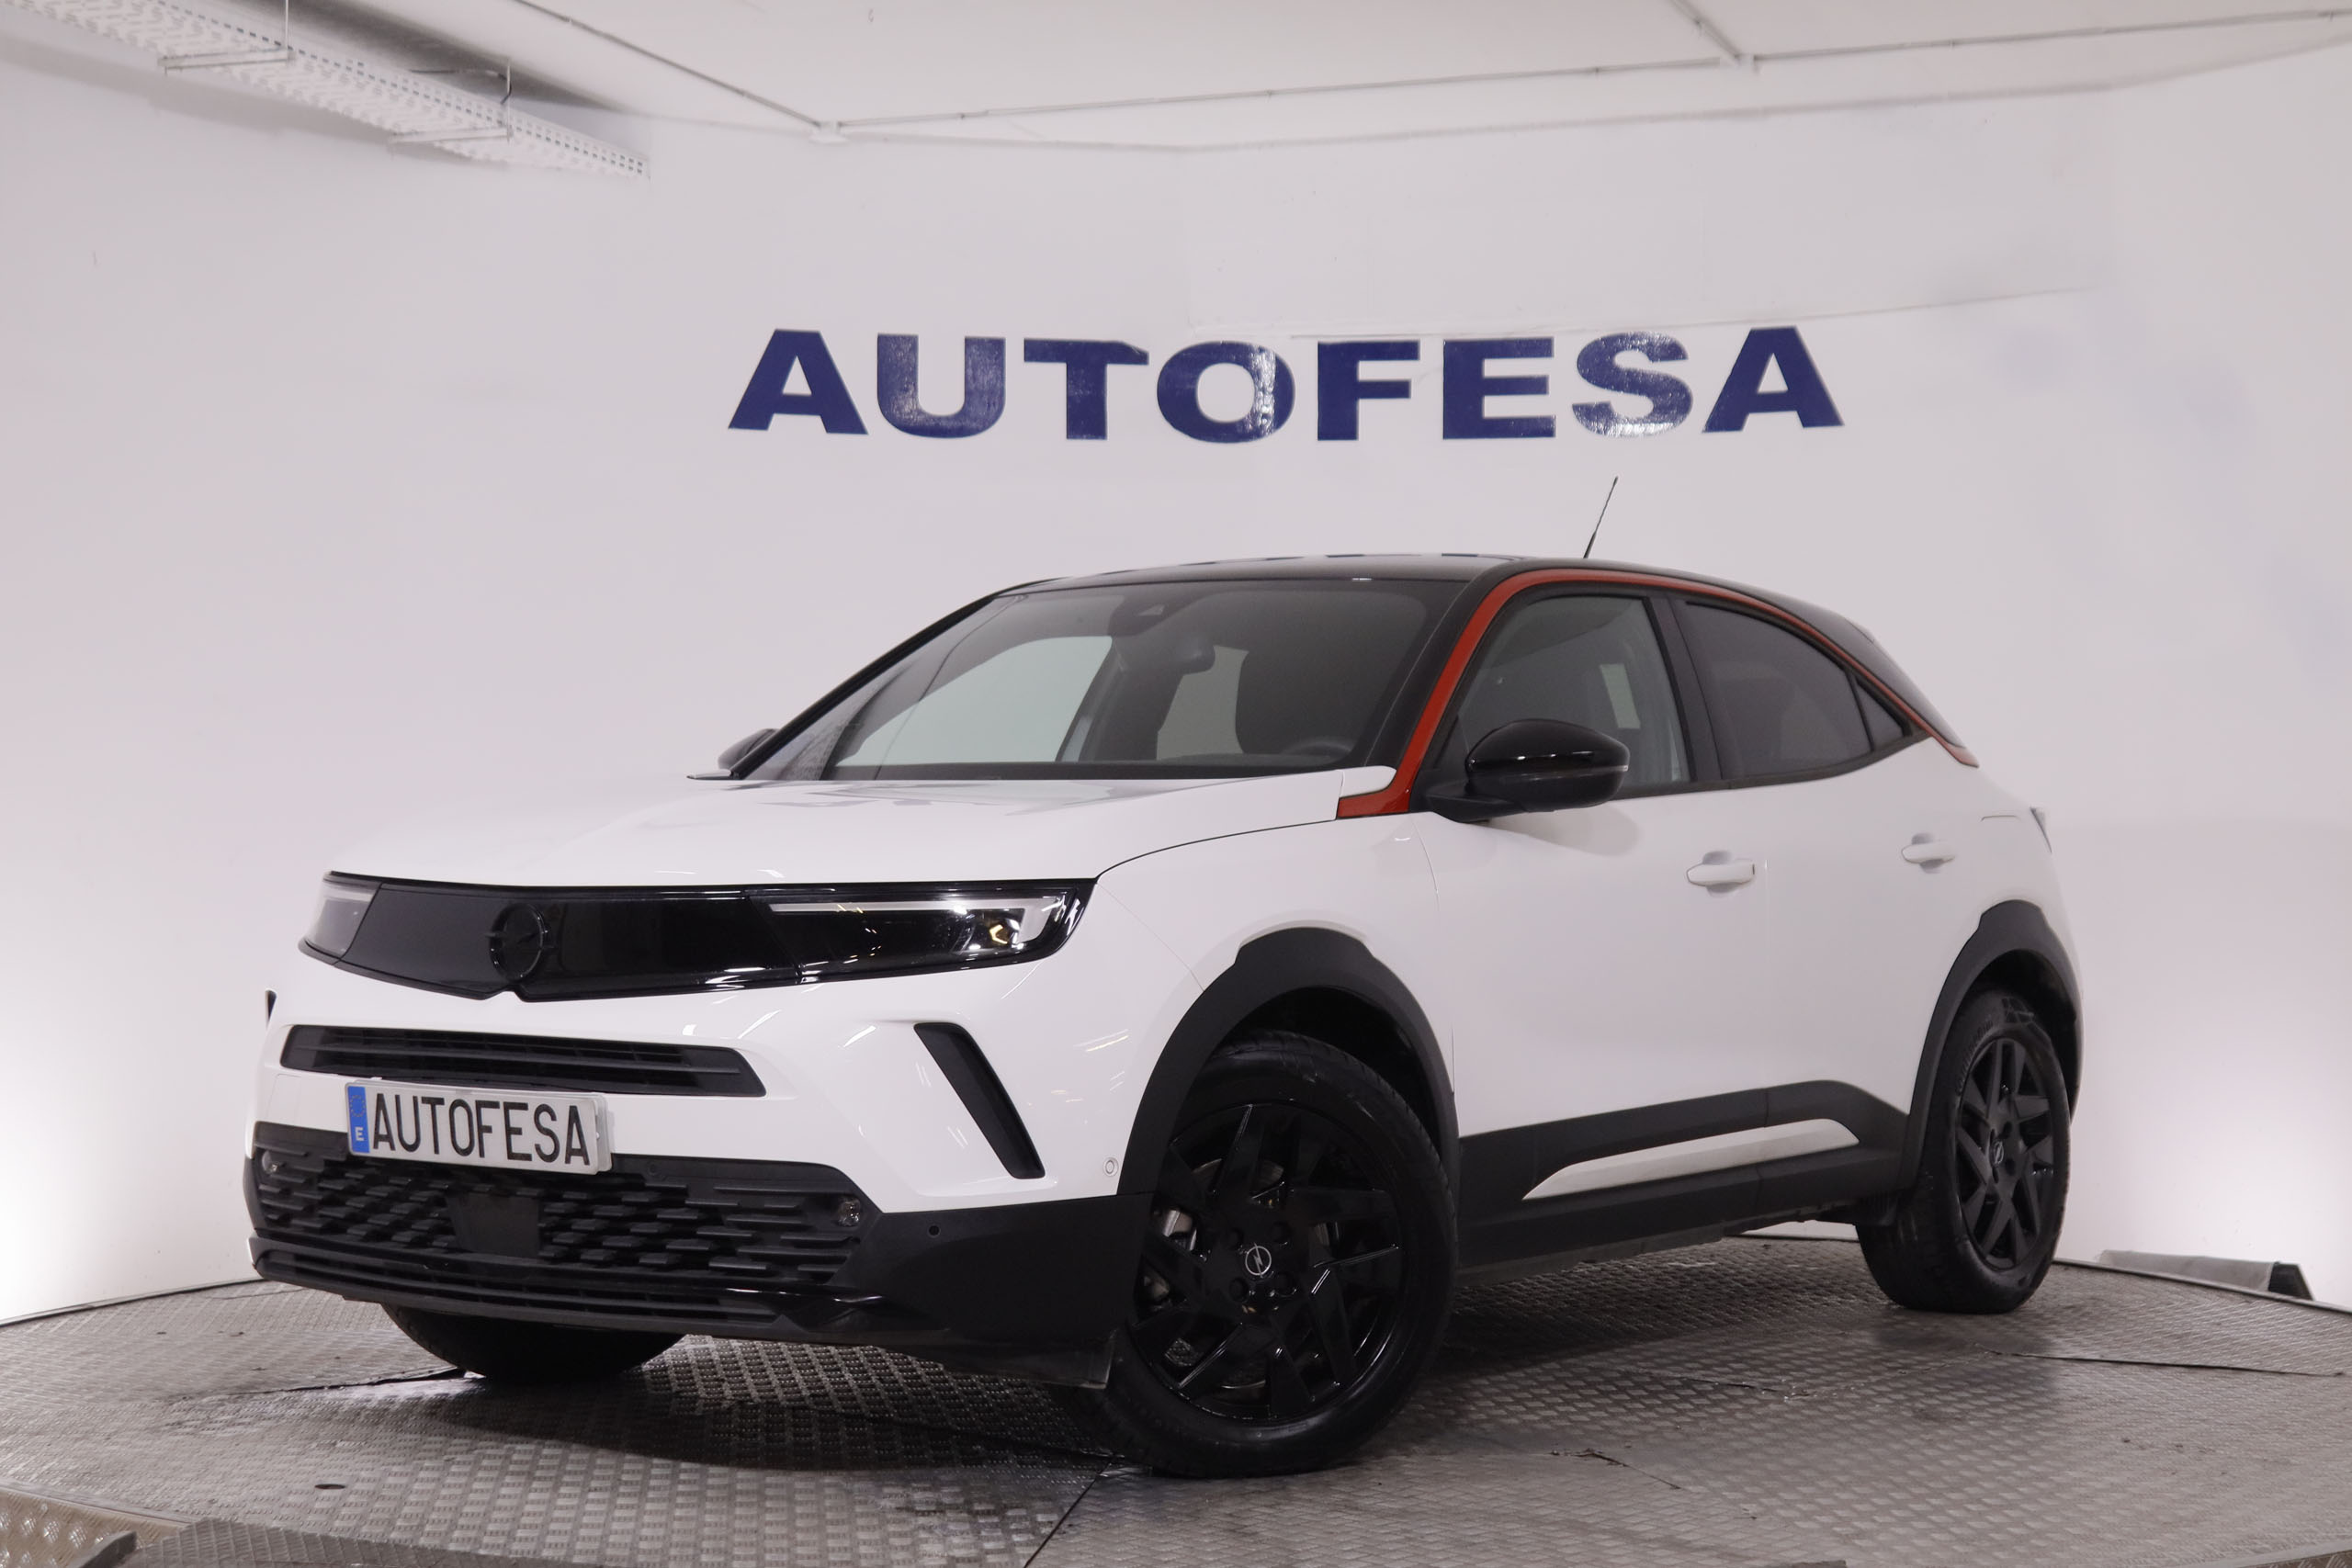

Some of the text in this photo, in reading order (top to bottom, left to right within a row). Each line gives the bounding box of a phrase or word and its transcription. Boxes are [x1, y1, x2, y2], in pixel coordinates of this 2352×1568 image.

[728, 326, 1844, 443] AUTOFESA
[355, 1093, 590, 1166] E AUTOFESA
